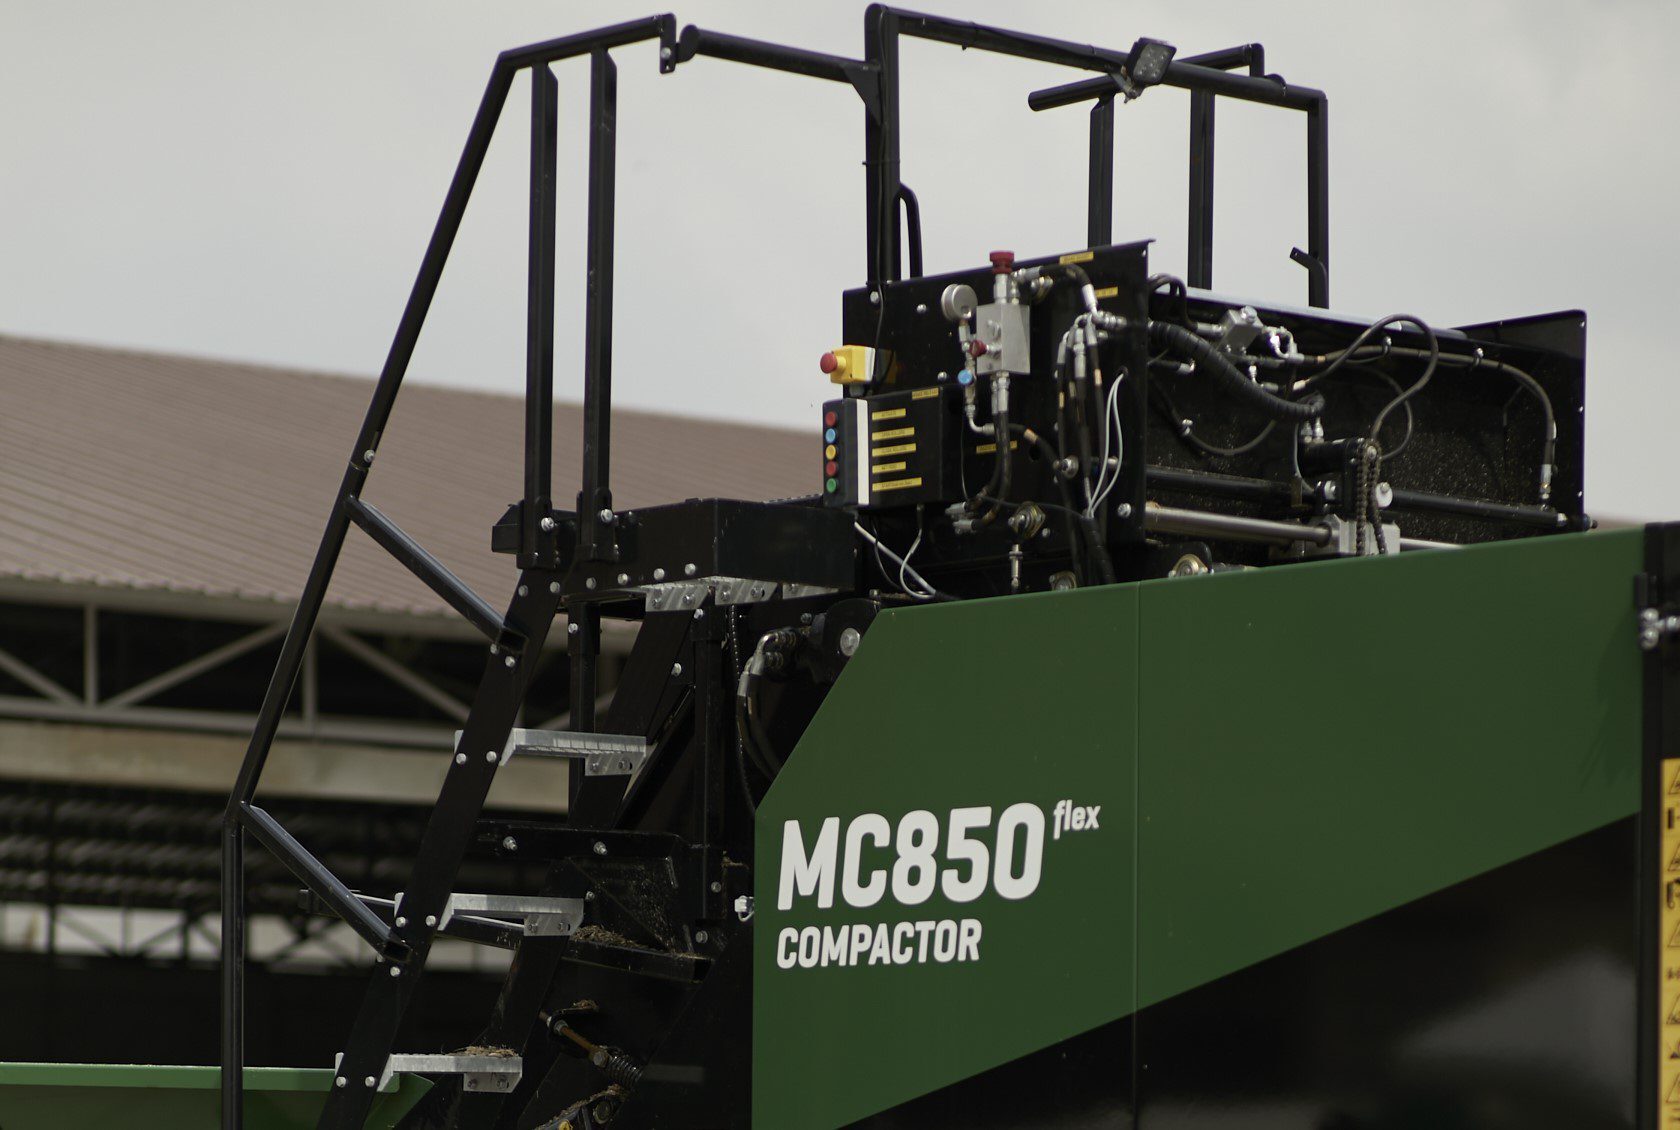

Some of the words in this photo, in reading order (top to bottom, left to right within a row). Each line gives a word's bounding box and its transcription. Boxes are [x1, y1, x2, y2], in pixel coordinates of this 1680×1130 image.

[777, 802, 1046, 911] MC850
[1053, 799, 1101, 840] flex
[776, 918, 983, 969] COMPACTOR
